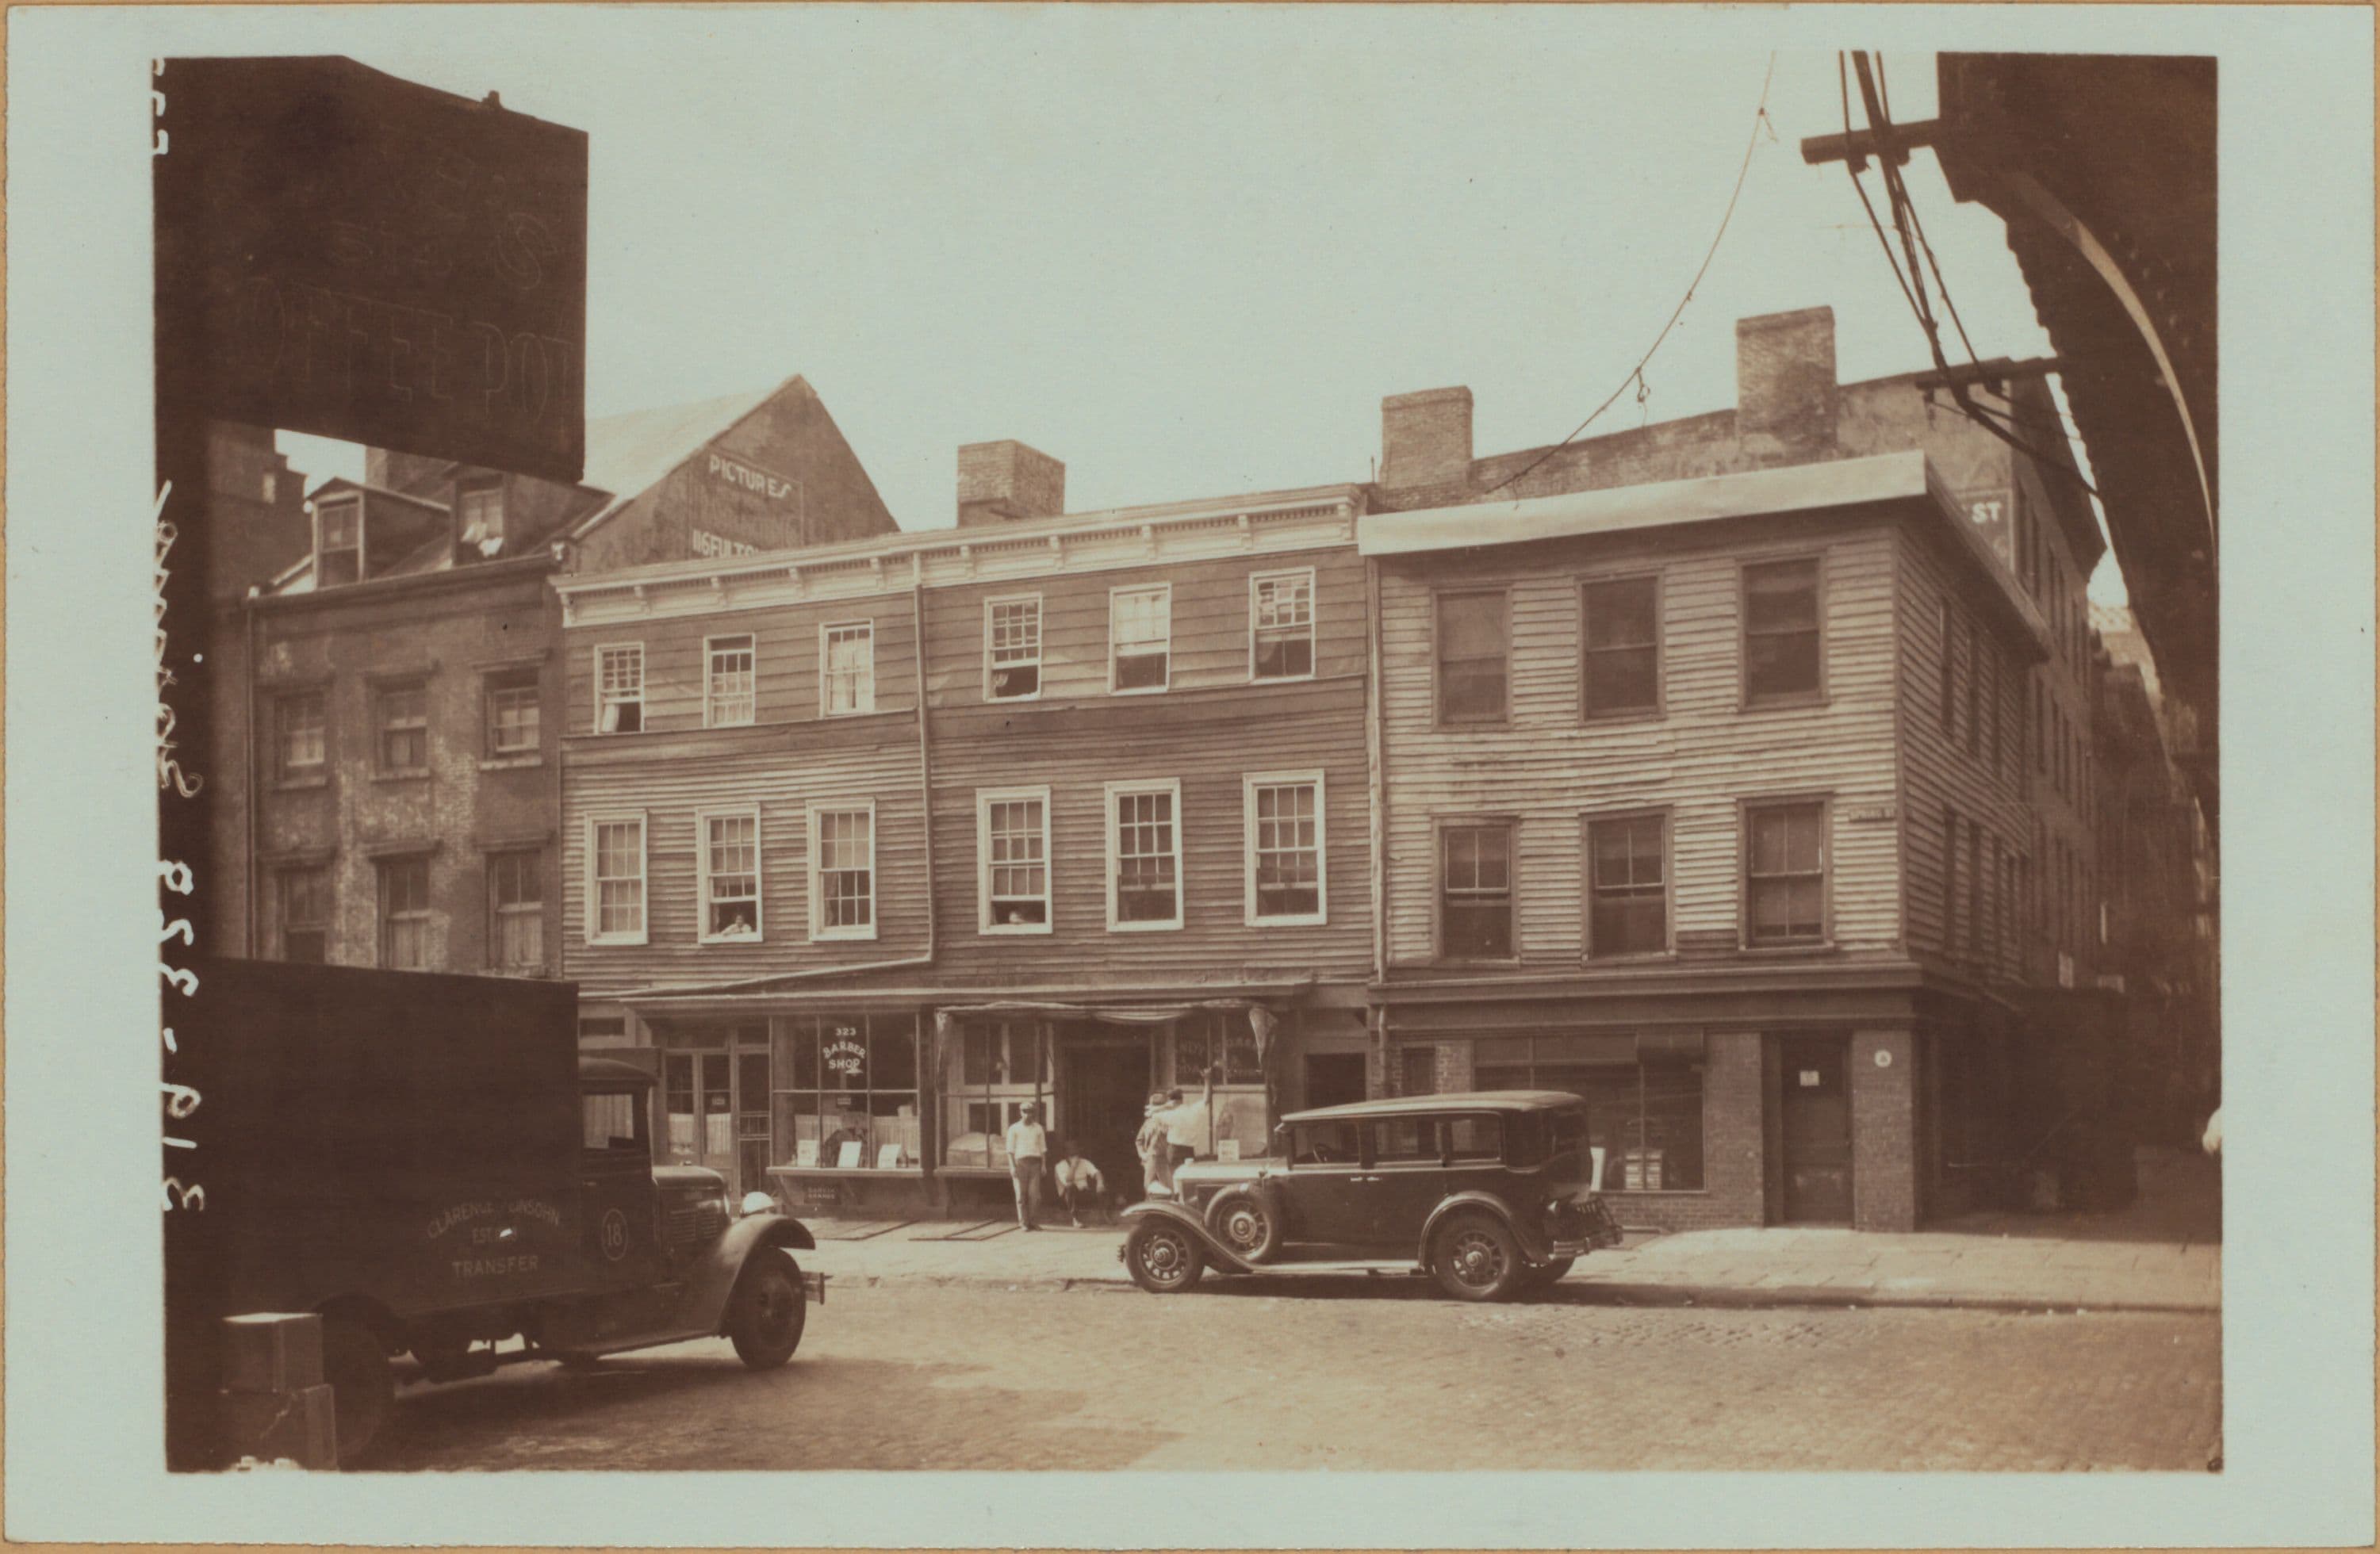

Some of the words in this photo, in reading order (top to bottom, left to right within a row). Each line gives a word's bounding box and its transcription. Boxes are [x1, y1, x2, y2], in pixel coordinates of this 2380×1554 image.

[710, 454, 792, 499] PICTURES
[1972, 500, 2002, 524] ST
[835, 1027, 857, 1036] 323
[823, 1040, 866, 1059] BARBER
[829, 1058, 860, 1070] SHOP
[607, 1223, 623, 1246] 18
[451, 1254, 539, 1279] TRANSFER
